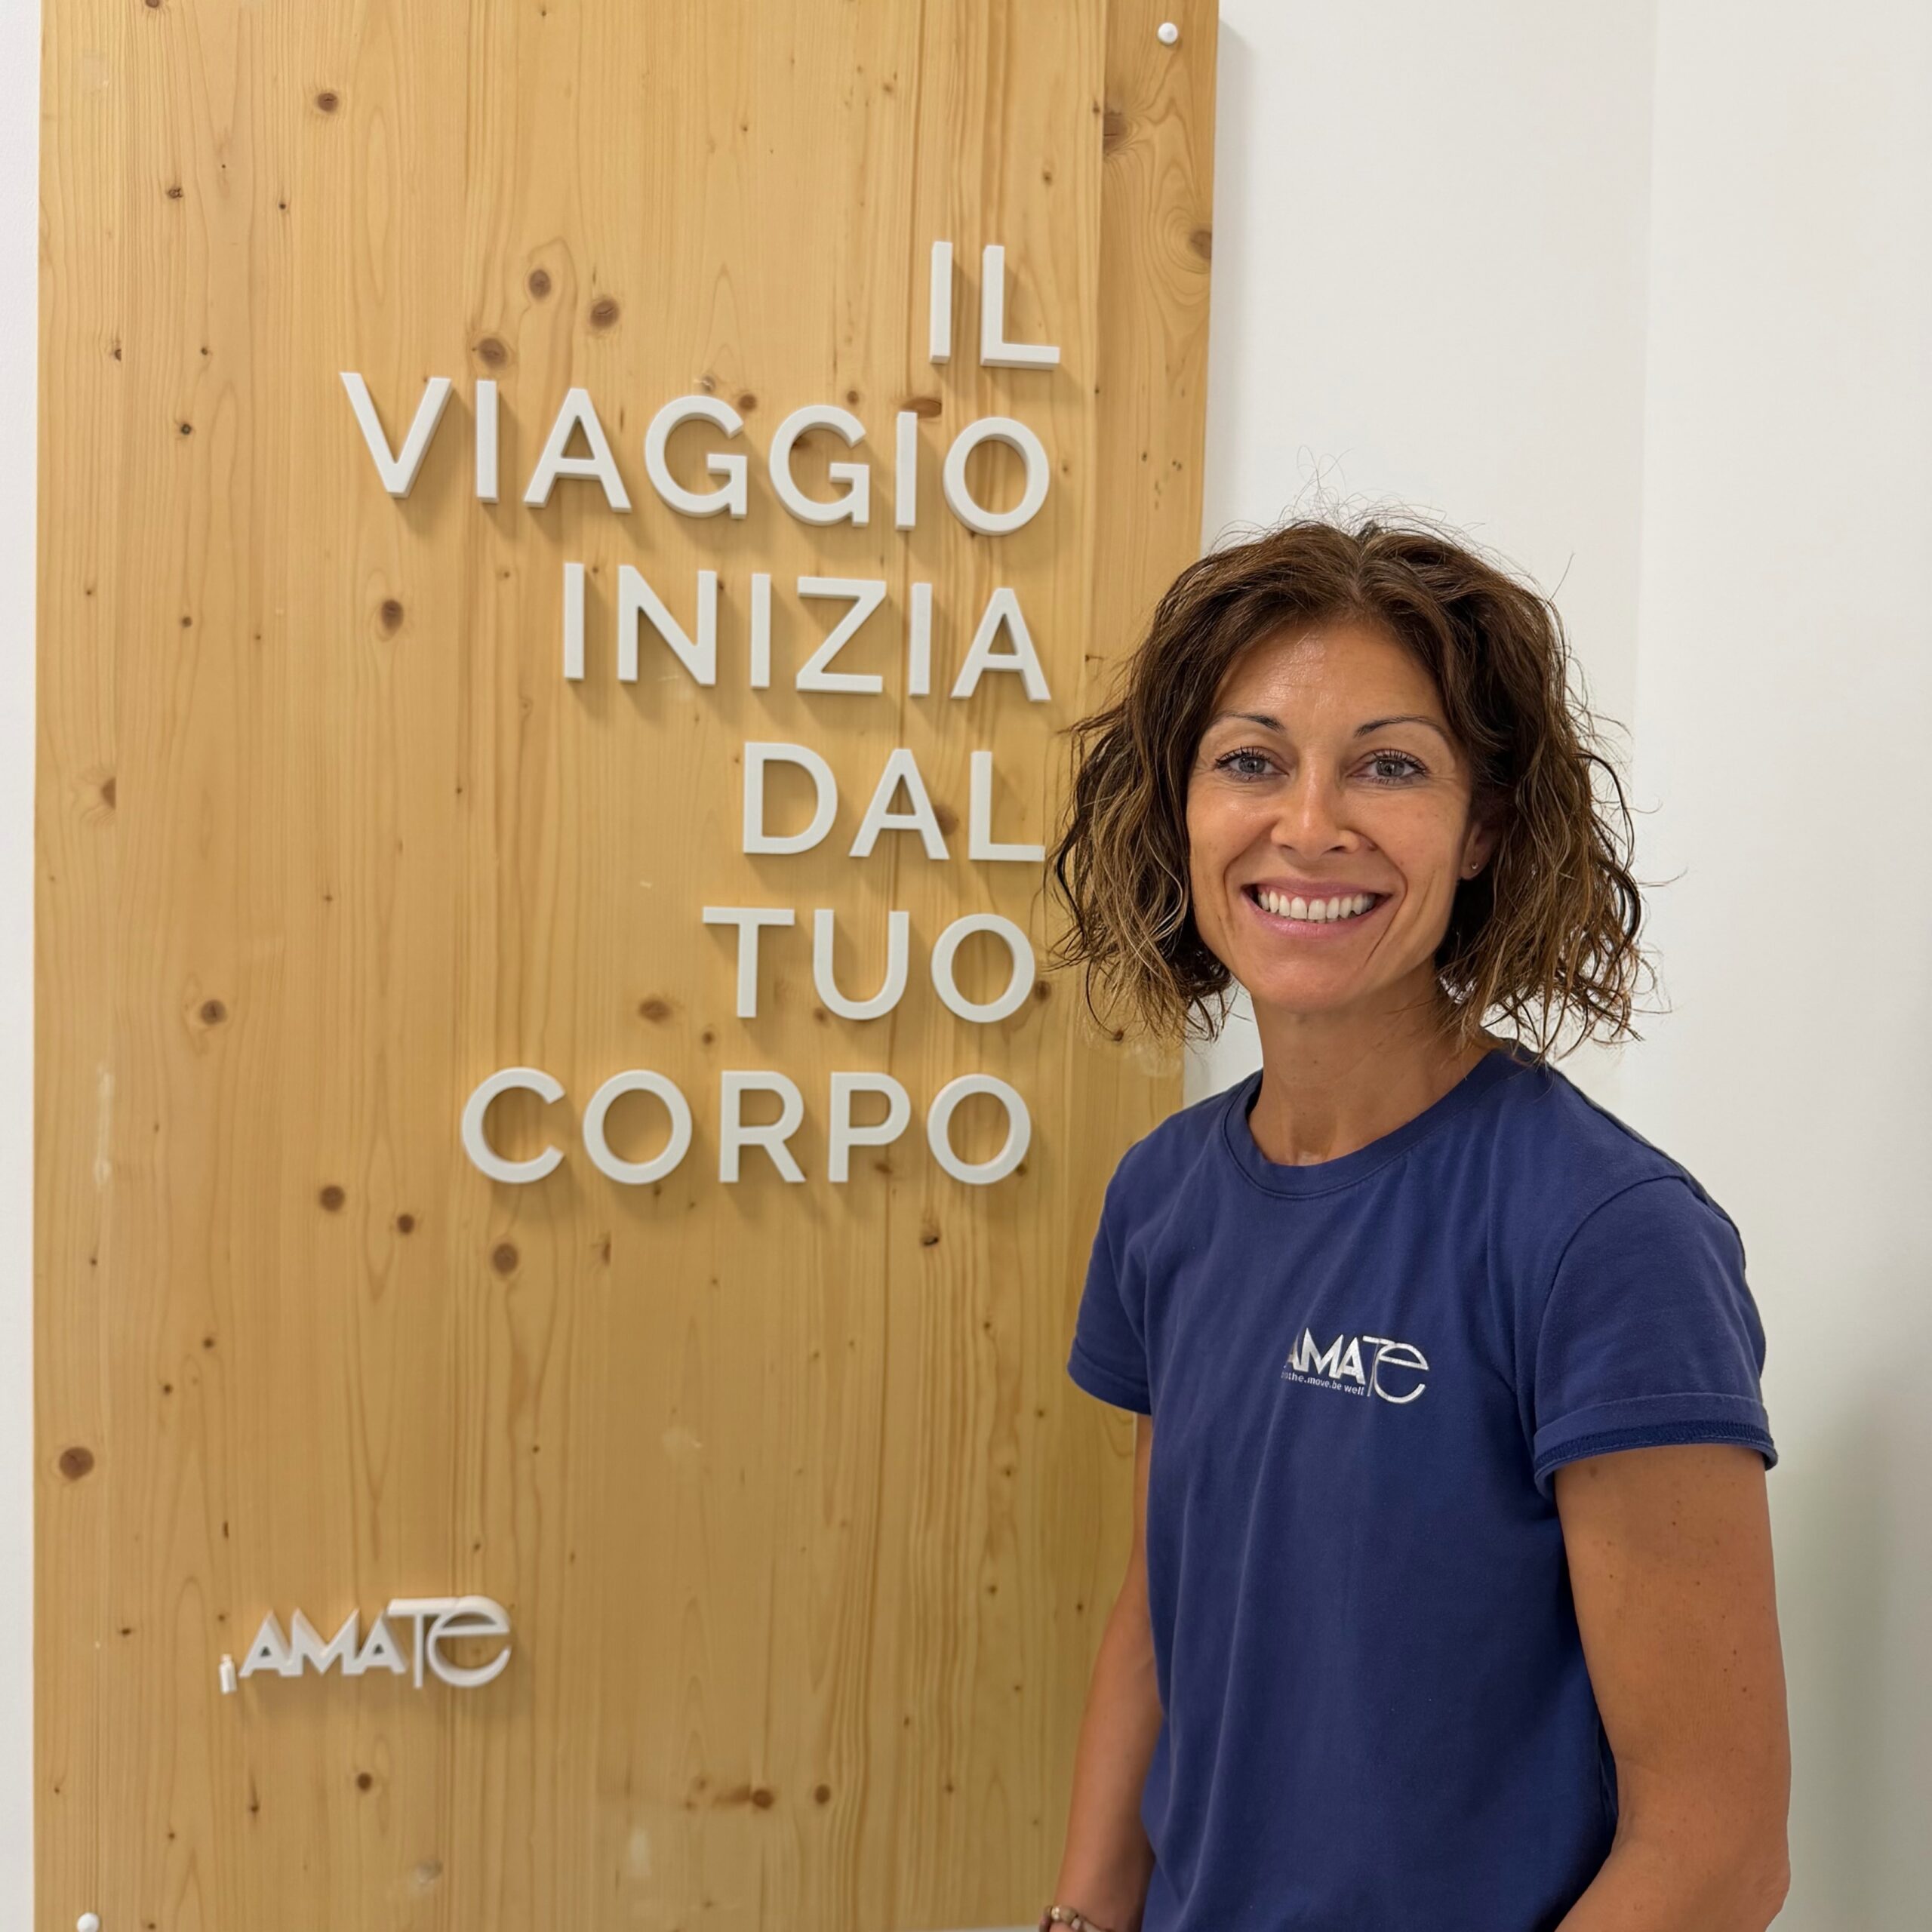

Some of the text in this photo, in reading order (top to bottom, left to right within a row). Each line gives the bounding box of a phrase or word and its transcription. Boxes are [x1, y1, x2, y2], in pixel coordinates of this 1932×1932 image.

[929, 240, 1060, 371] IL
[340, 372, 1051, 536] VIAGGIO
[563, 562, 1051, 702] INIZIA
[742, 742, 1046, 862] DAL
[702, 906, 1036, 1023] TUO
[461, 1066, 1032, 1186] CORPO
[1344, 1385, 1364, 1396] well
